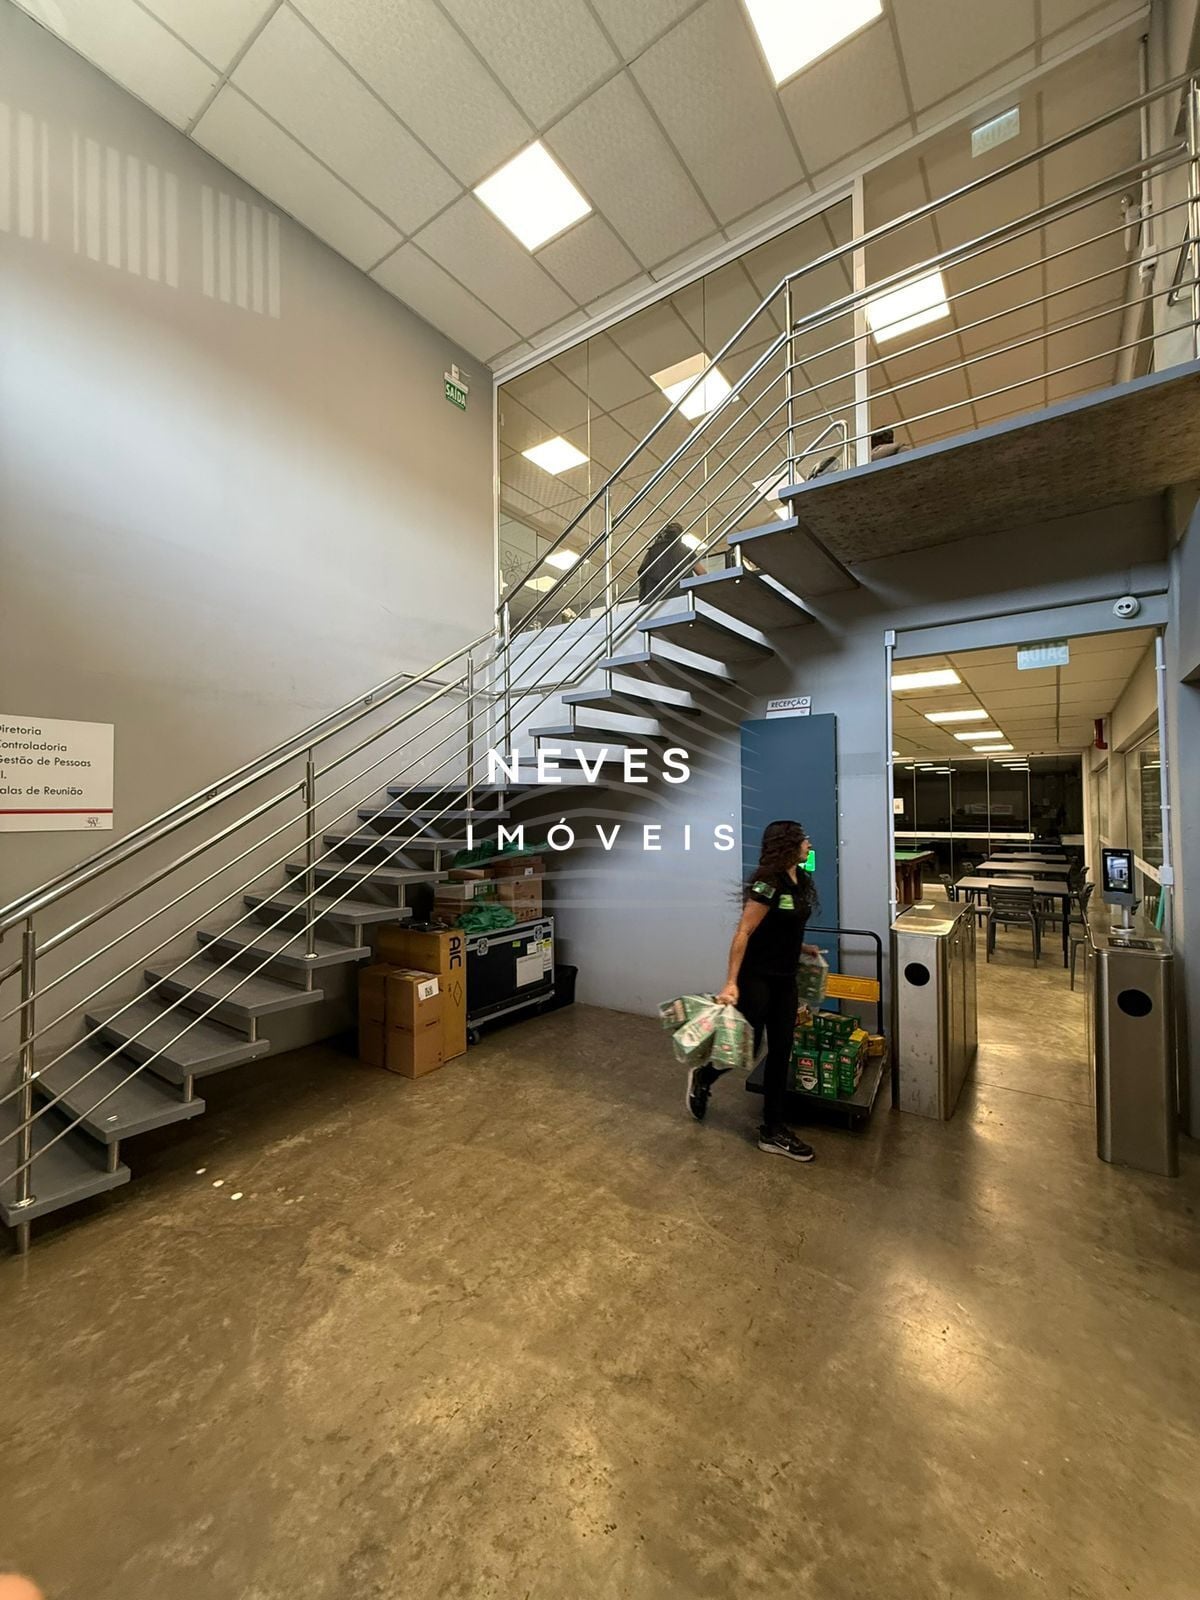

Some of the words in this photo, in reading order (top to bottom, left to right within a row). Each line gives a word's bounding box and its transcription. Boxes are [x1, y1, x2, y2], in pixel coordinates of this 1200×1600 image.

[770, 698, 808, 708] RECEPÇÃO
[0, 724, 42, 736] iretoria
[0, 741, 67, 752] ontroladoria
[36, 757, 51, 766] de
[54, 757, 91, 767] Pessoas
[0, 785, 23, 795] alas
[26, 786, 40, 795] de
[43, 786, 83, 796] Reunião
[449, 936, 462, 971] AIC
